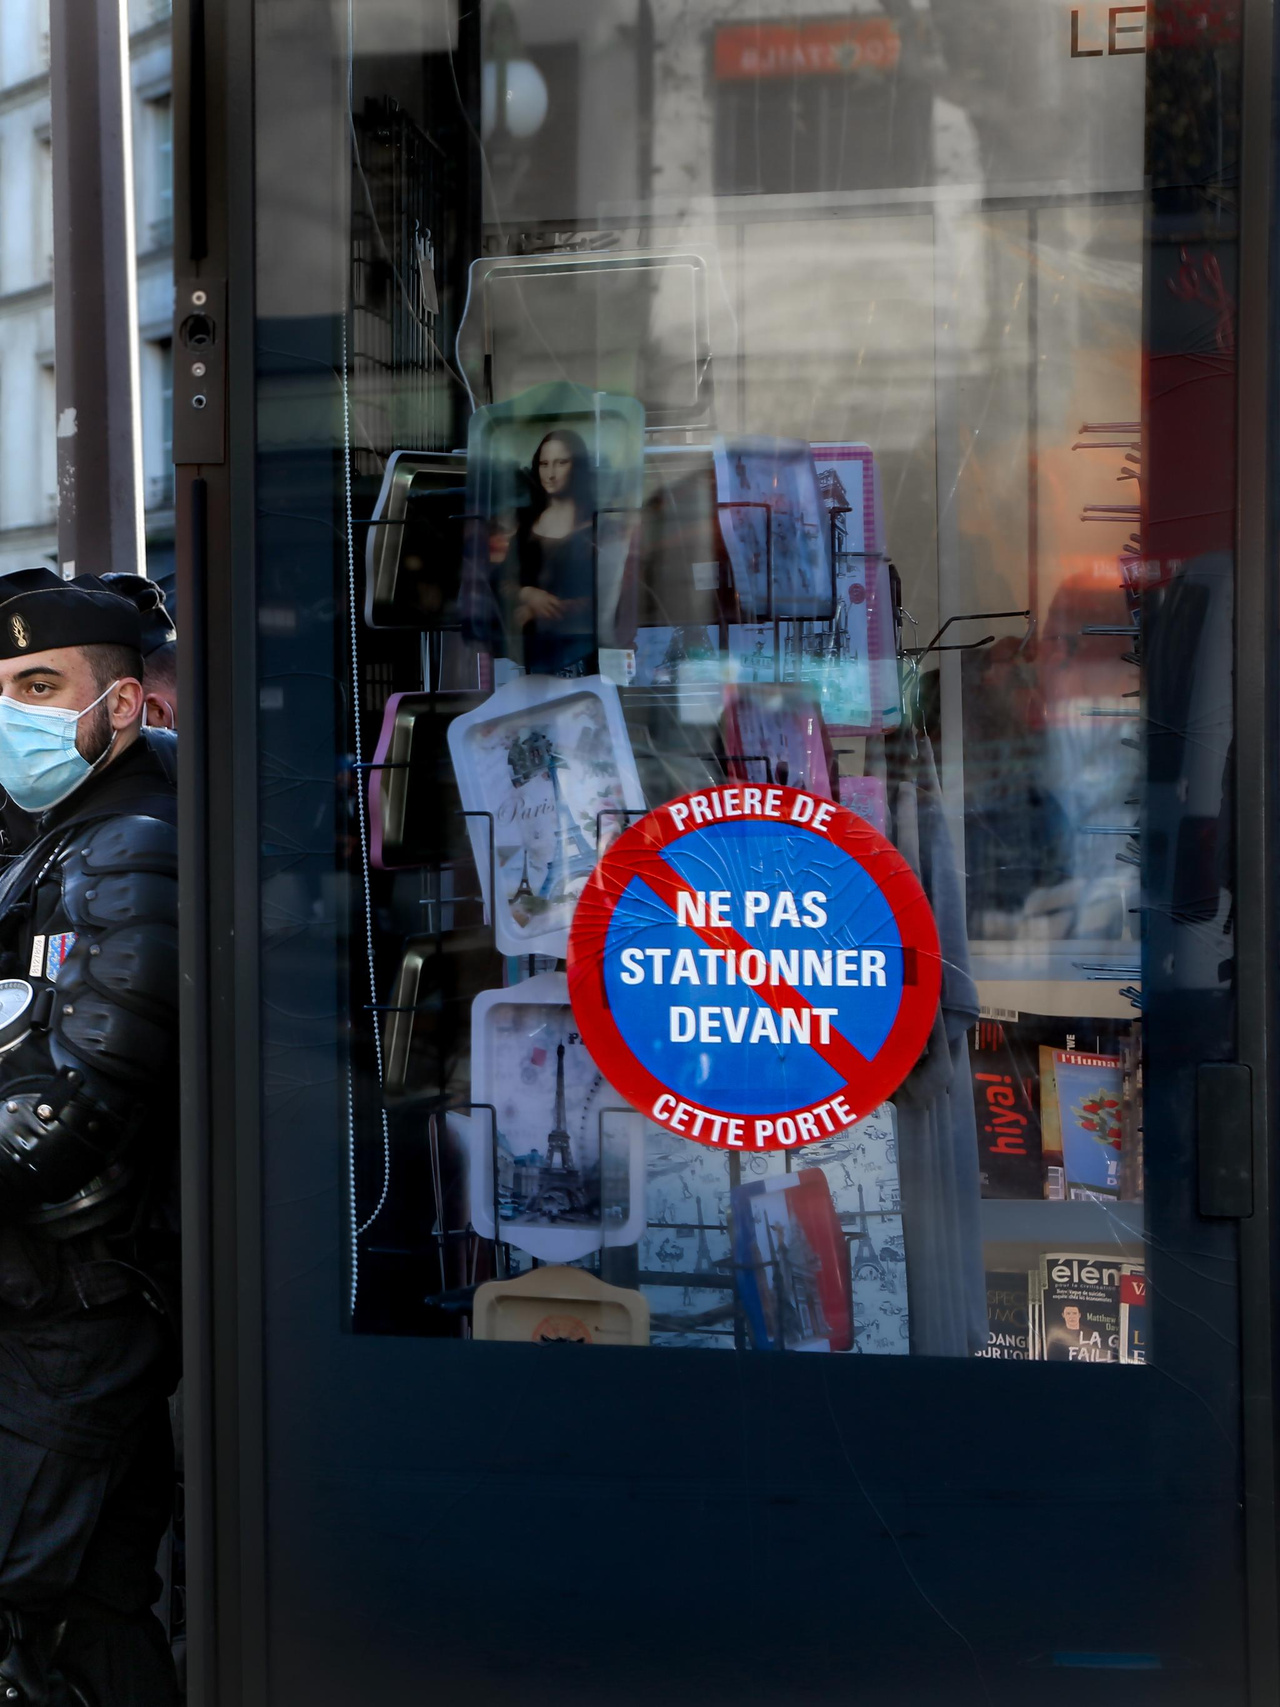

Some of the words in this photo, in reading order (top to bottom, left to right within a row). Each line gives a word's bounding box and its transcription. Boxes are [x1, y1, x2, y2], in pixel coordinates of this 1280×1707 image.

[1070, 6, 1146, 58] LE
[670, 788, 782, 832] PRIERE
[791, 790, 838, 834] DE
[676, 891, 733, 928] NE
[745, 891, 827, 928] PAS
[619, 948, 887, 987] STATIONNER
[669, 1007, 839, 1045] DEVANT
[652, 1093, 746, 1147] CETTE
[755, 1094, 858, 1148] PORTE
[975, 1072, 1027, 1155] hiya!
[1086, 1313, 1116, 1323] Matthew
[988, 1331, 1029, 1348] DANG
[1079, 1330, 1102, 1348] LA
